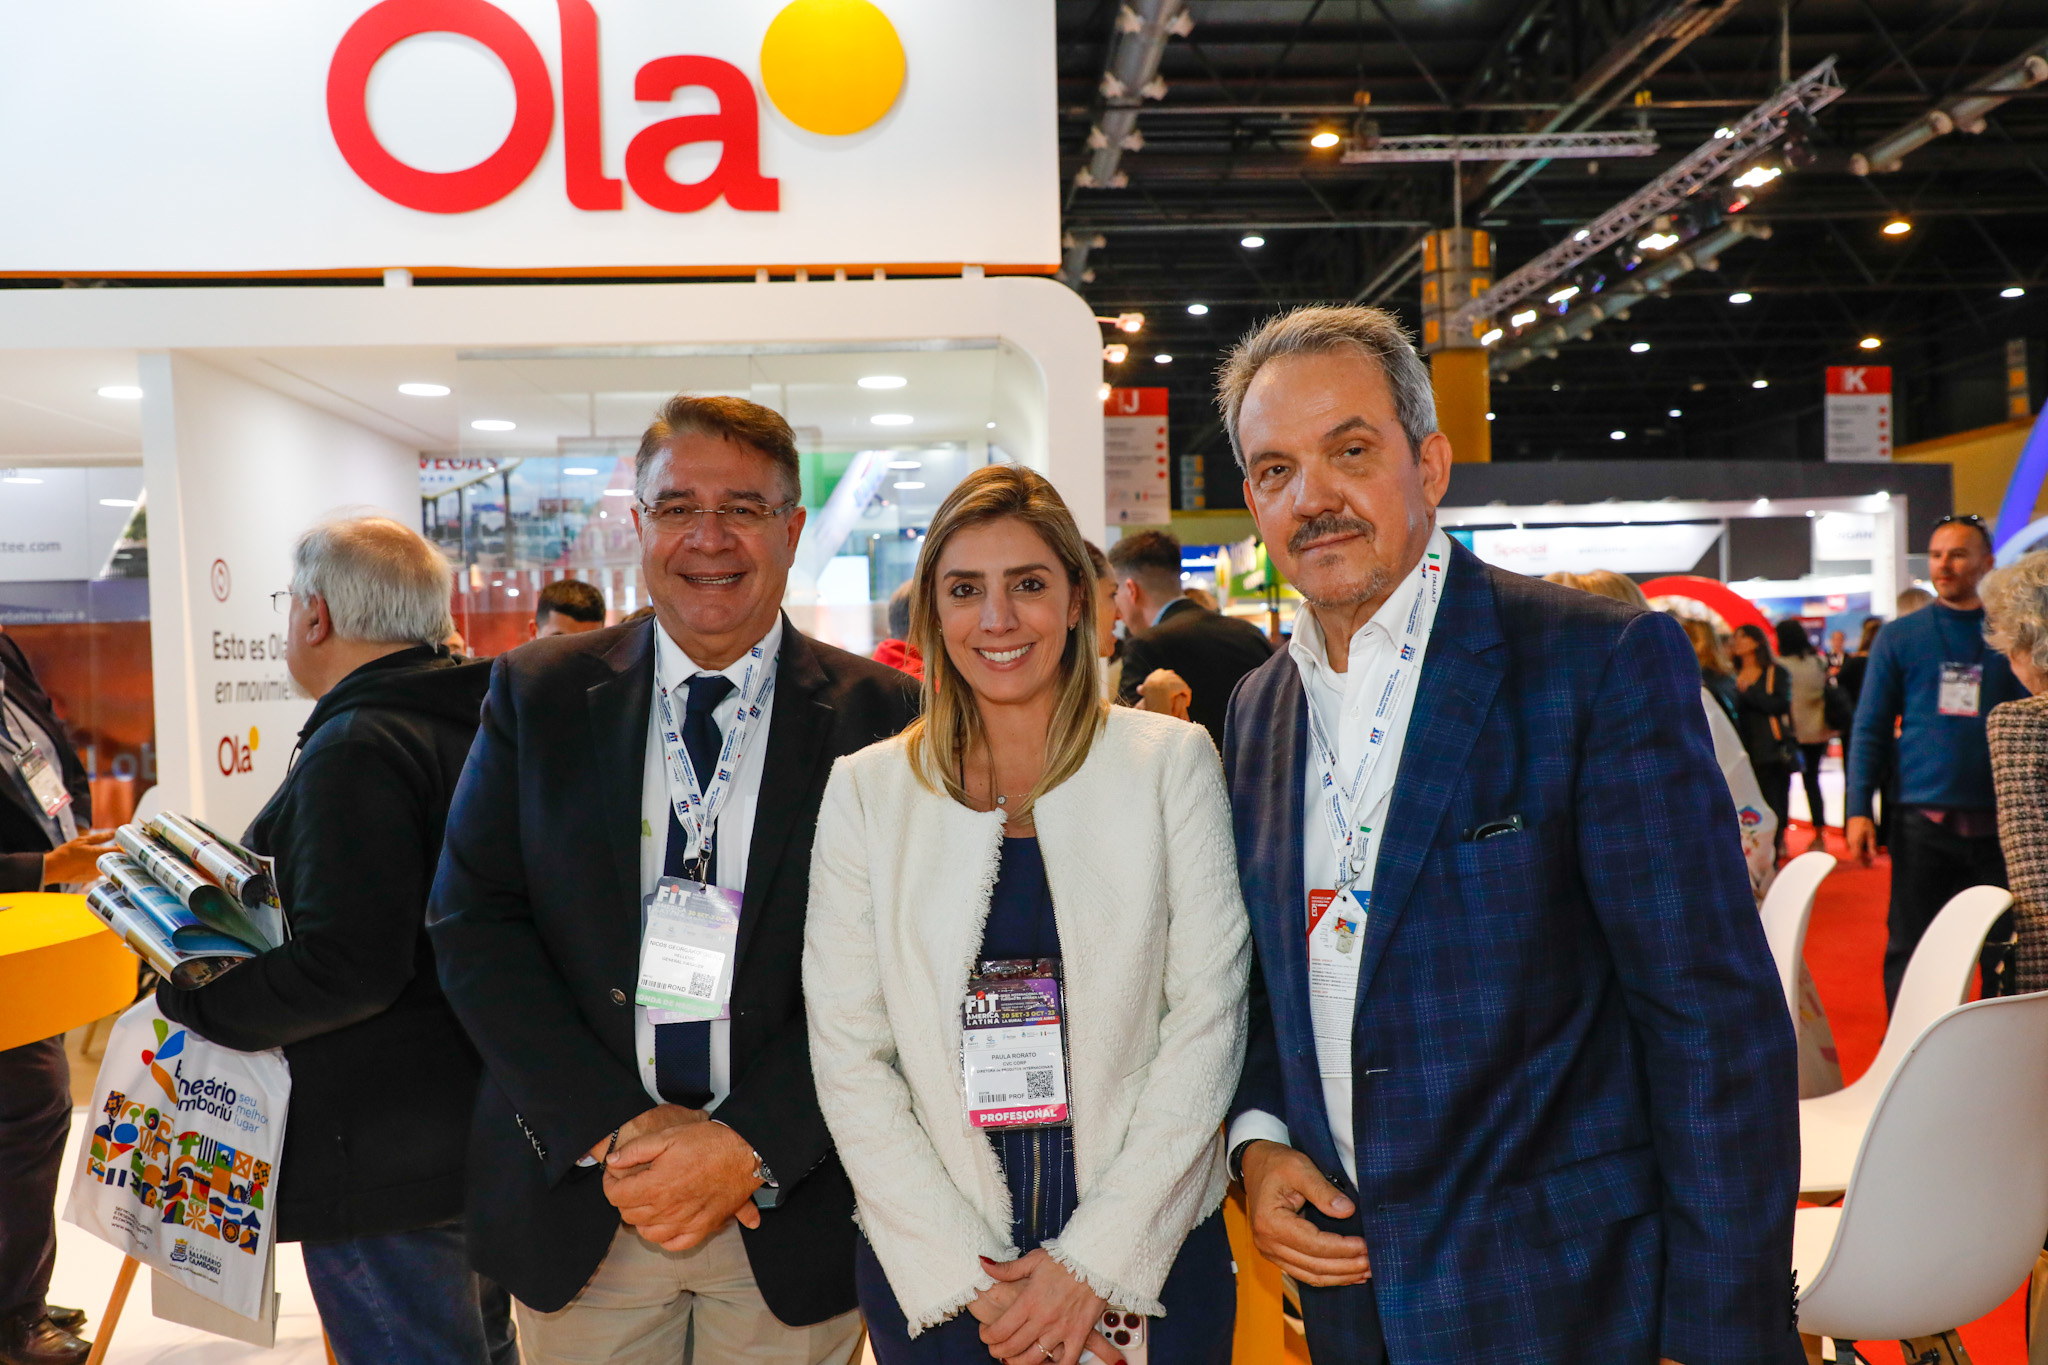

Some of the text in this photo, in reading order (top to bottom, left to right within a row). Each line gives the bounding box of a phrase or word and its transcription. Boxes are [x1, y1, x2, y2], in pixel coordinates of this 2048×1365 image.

[326, 0, 780, 214] Ola
[1844, 367, 1867, 391] K
[1123, 389, 1139, 413] J
[213, 630, 288, 660] Esto es Ola
[215, 674, 293, 703] en movimie
[217, 735, 254, 776] Ola
[649, 940, 667, 949] NICOS
[668, 983, 687, 992] ROND
[966, 1012, 1000, 1020] AMERICA
[966, 1018, 1000, 1026] LATINA
[239, 1093, 257, 1107] seu
[233, 1115, 260, 1134] lugar
[980, 1108, 1058, 1123] PROFESIONAL
